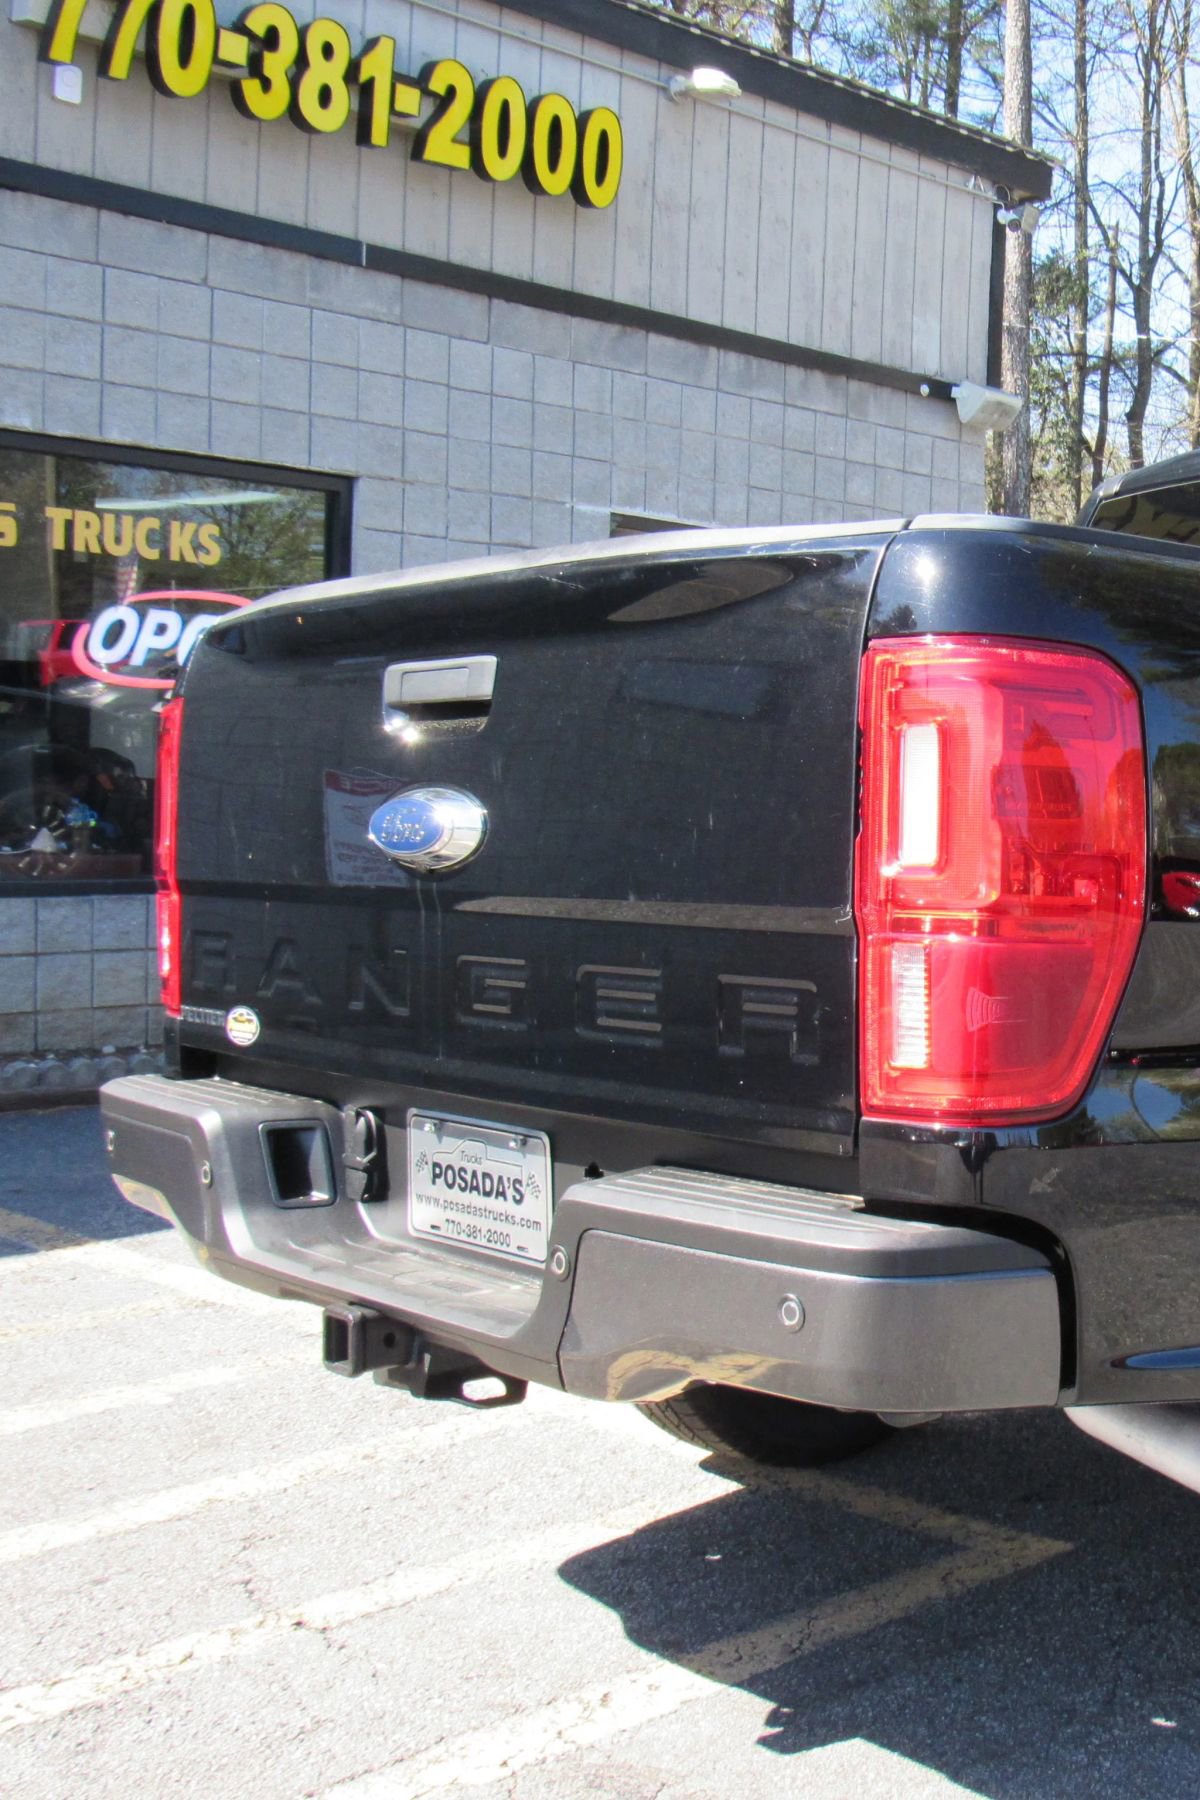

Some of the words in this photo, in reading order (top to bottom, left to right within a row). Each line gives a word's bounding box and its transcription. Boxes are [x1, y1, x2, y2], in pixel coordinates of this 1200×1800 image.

[45, 507, 221, 566] TRUCKS
[88, 605, 219, 666] OP
[190, 929, 820, 1066] RANGER
[460, 1150, 483, 1165] Trucks
[432, 1161, 525, 1205] POSADA'S
[416, 1193, 542, 1232] www.posadastrucks.com
[445, 1218, 511, 1248] 770-381-2000
